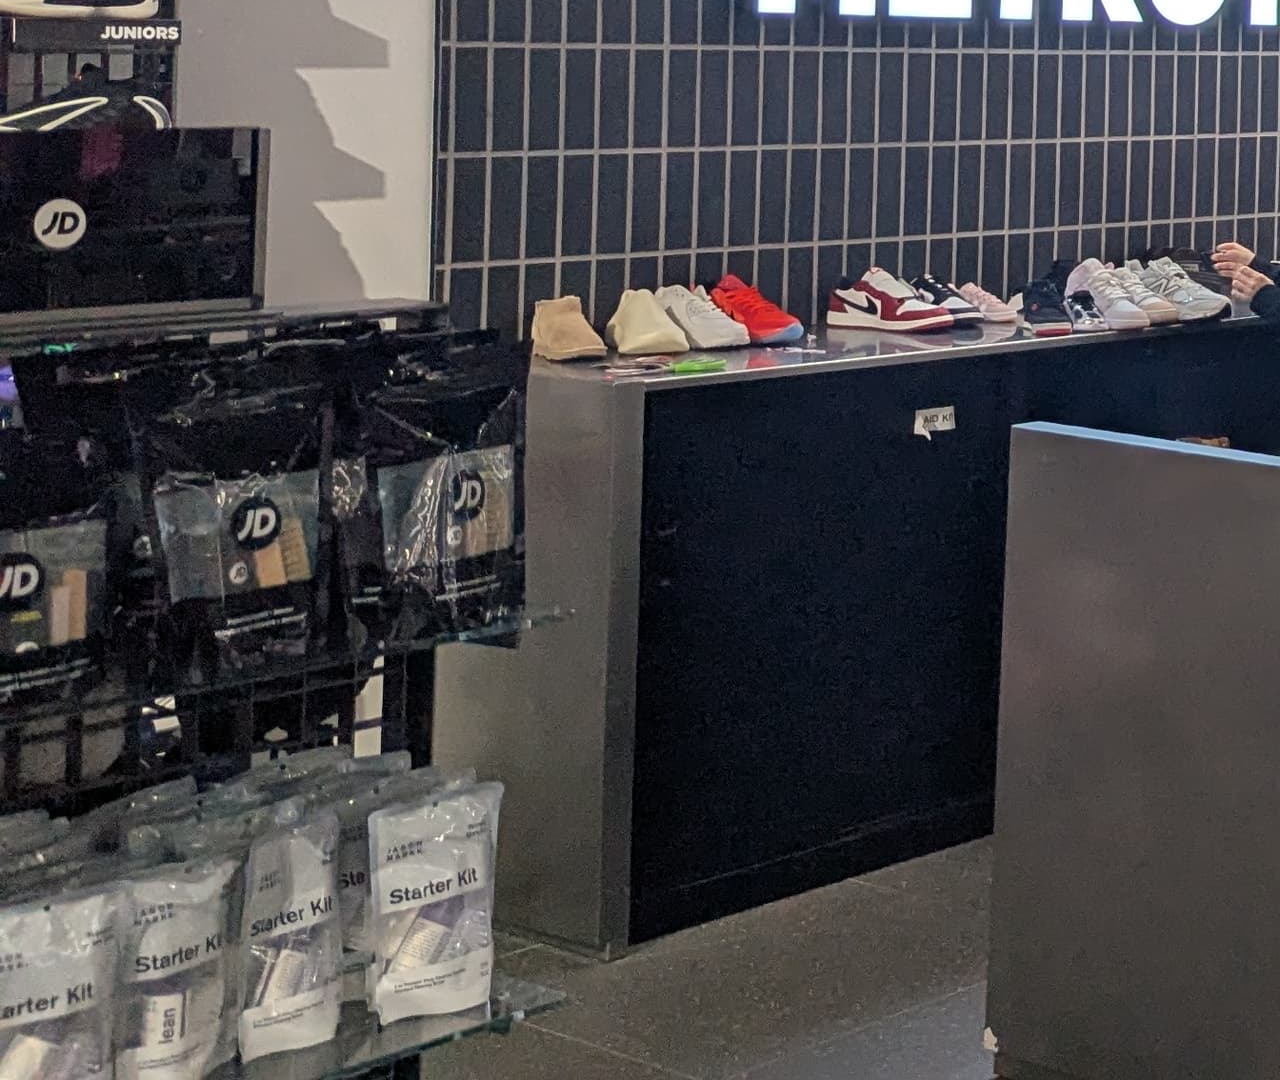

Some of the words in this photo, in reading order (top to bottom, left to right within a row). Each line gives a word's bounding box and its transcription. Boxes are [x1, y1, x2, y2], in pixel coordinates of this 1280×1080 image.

[101, 26, 179, 40] JUNIORS
[923, 414, 939, 424] AID
[389, 877, 452, 905] Starter
[457, 868, 478, 887] Kit
[250, 907, 305, 937] Starter
[311, 896, 333, 915] Kit
[135, 944, 200, 973] Starter
[206, 935, 224, 952] Ki
[0, 996, 59, 1018] arter
[67, 982, 93, 1005] Kit
[158, 1007, 176, 1045] lean
